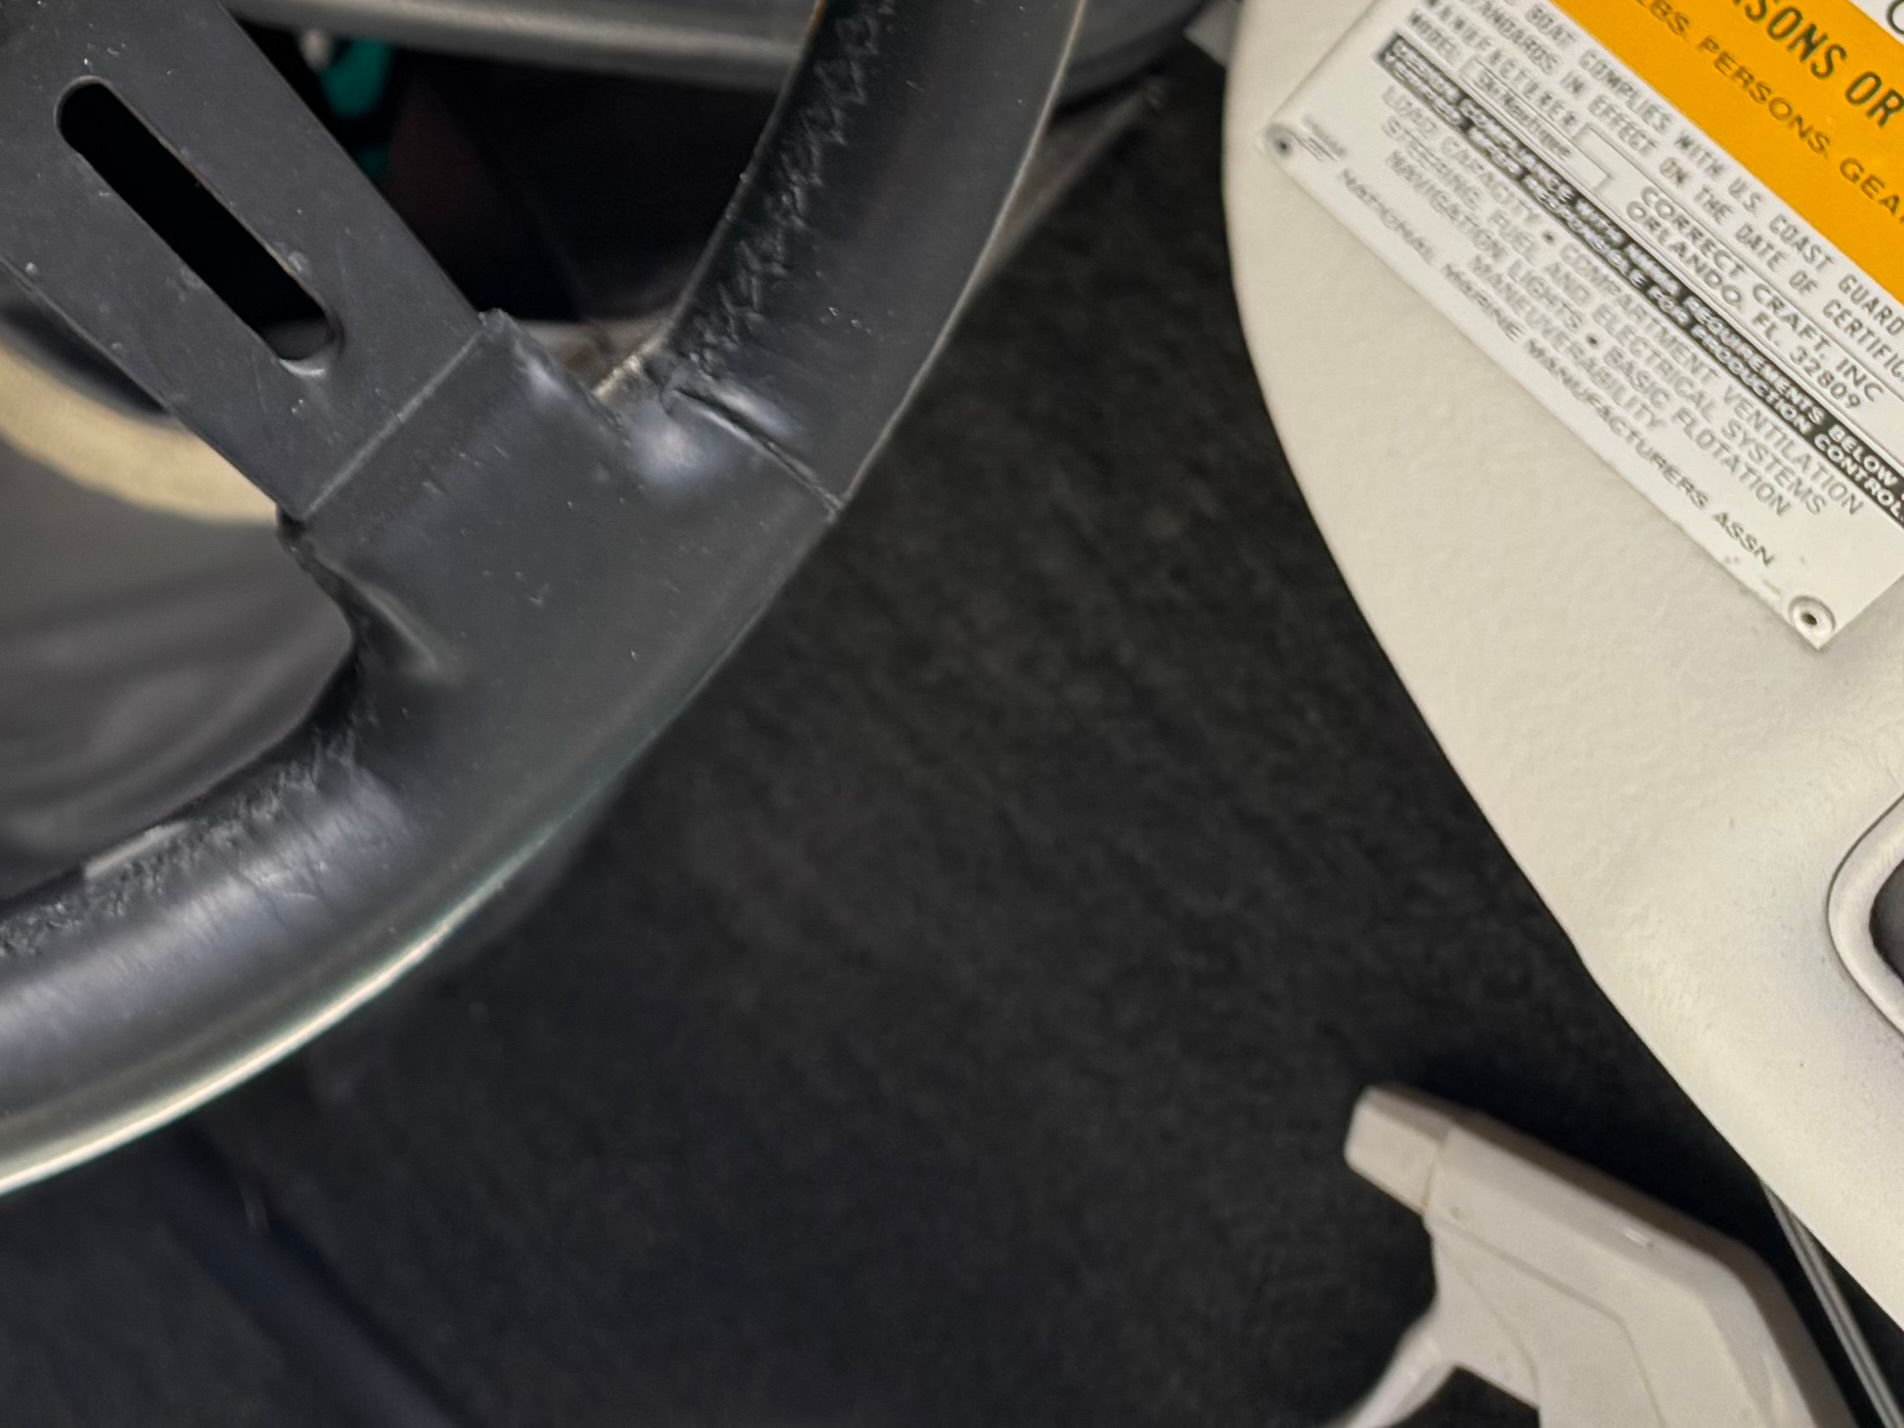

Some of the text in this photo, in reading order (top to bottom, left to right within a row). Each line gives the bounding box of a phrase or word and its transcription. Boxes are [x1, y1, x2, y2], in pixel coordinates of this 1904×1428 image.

[1846, 71, 1904, 129] OR
[1640, 186, 1745, 277] CORRECT
[1768, 214, 1834, 272] COAST
[1836, 275, 1904, 337] GUARD
[1789, 346, 1862, 412] 32809
